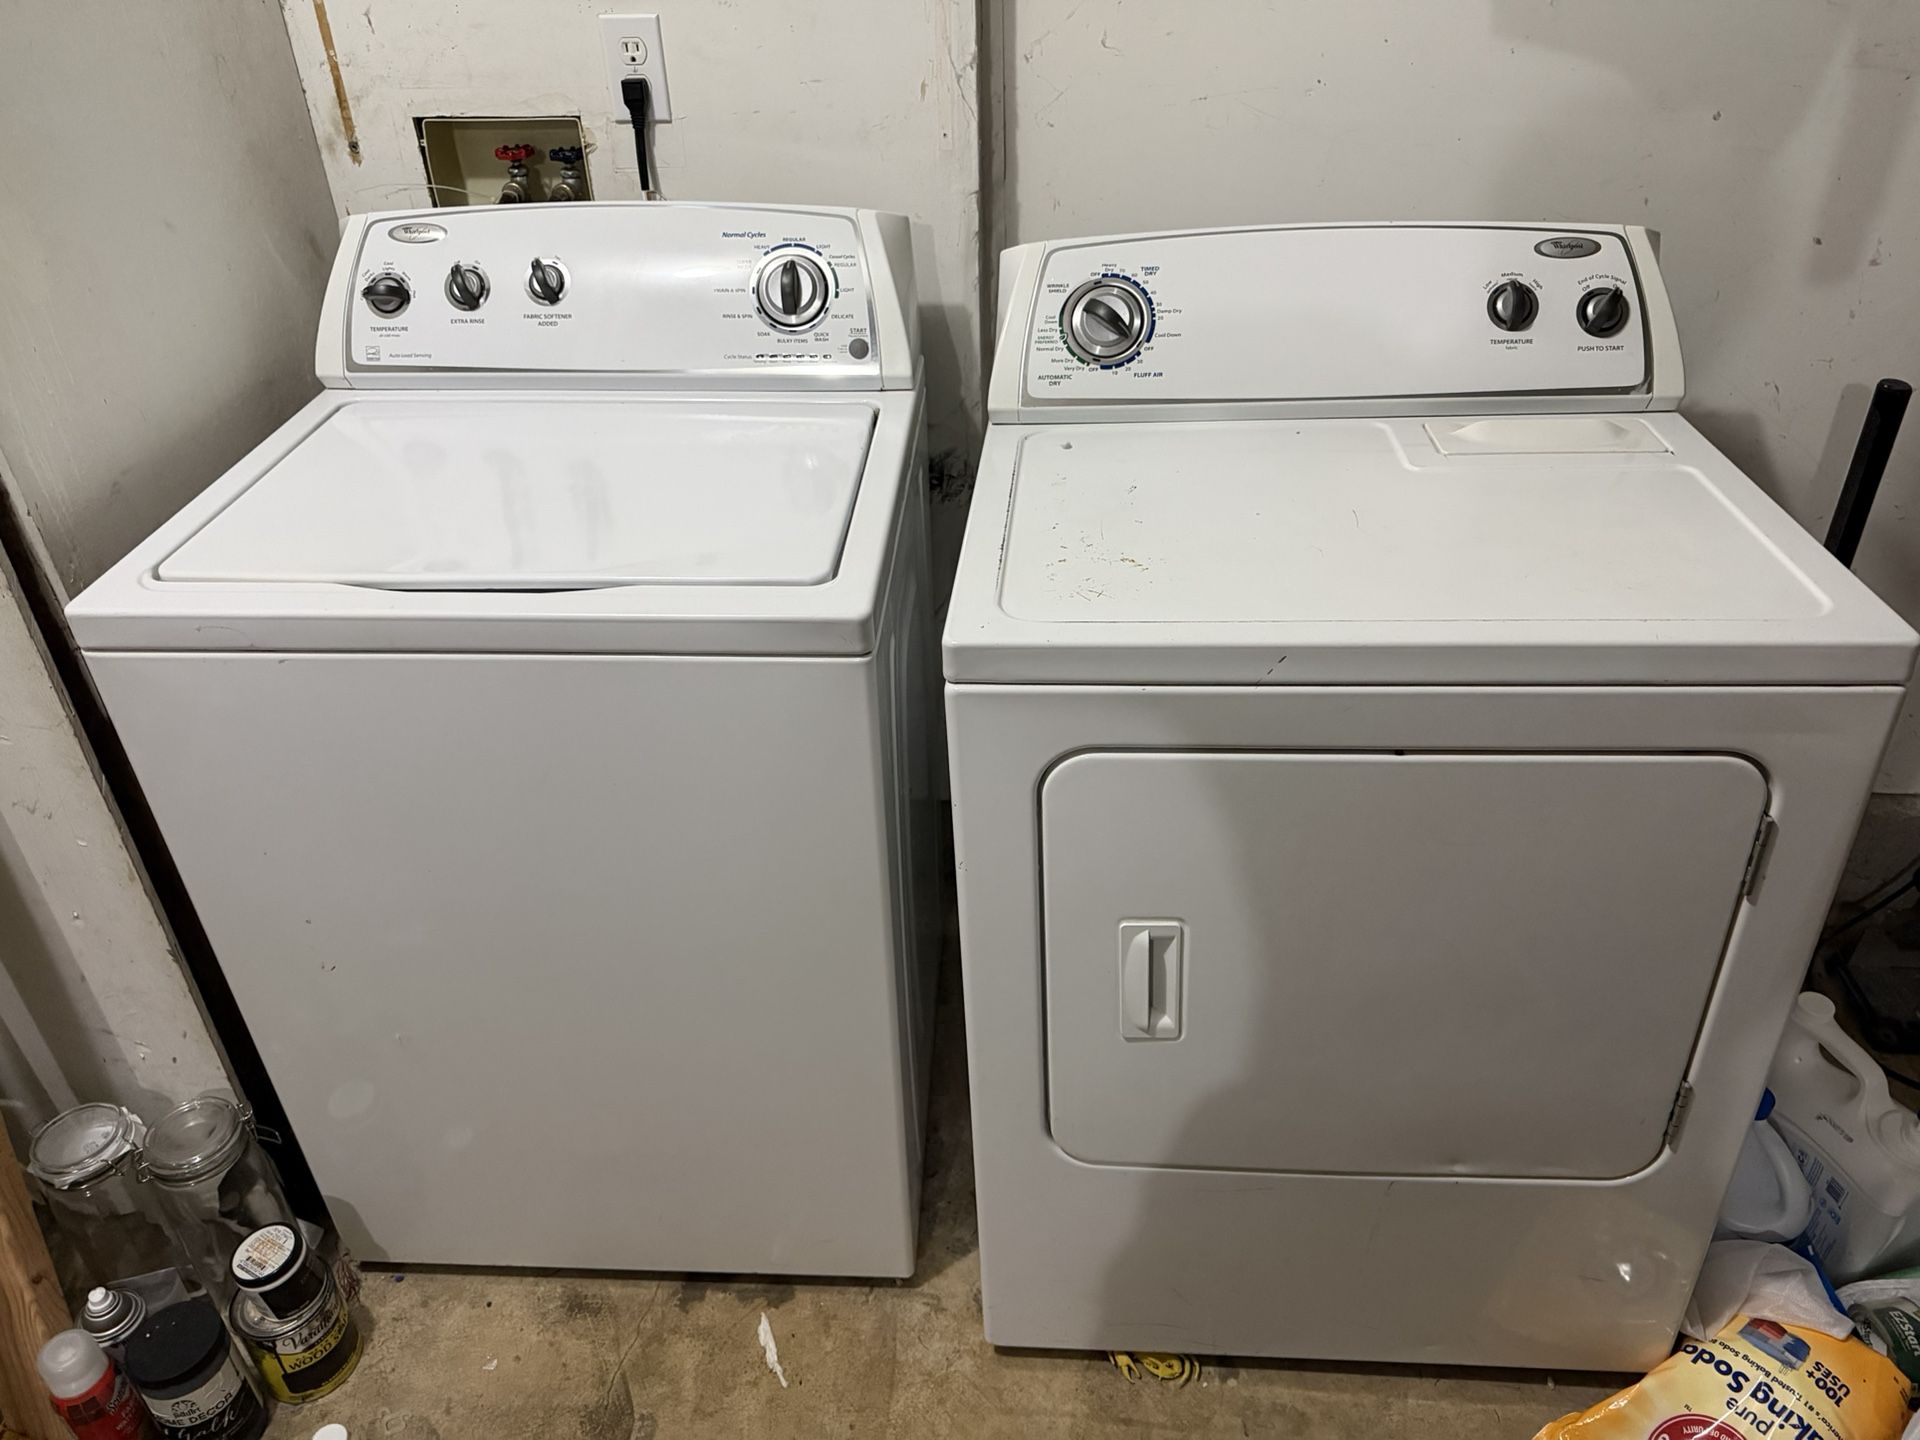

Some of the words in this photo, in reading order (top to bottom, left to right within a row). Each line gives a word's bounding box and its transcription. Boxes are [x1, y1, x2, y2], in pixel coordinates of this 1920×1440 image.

[1483, 280, 1492, 290] Low
[1577, 277, 1588, 285] End
[289, 1341, 334, 1371] WOOD
[1718, 1340, 1741, 1357] Soda
[1680, 1343, 1751, 1394] Soda
[1741, 1353, 1772, 1379] Baking
[1812, 1361, 1851, 1398] USES
[1806, 1369, 1844, 1408] 100+
[188, 1392, 233, 1424] DECOR
[1726, 1397, 1775, 1437] pure
